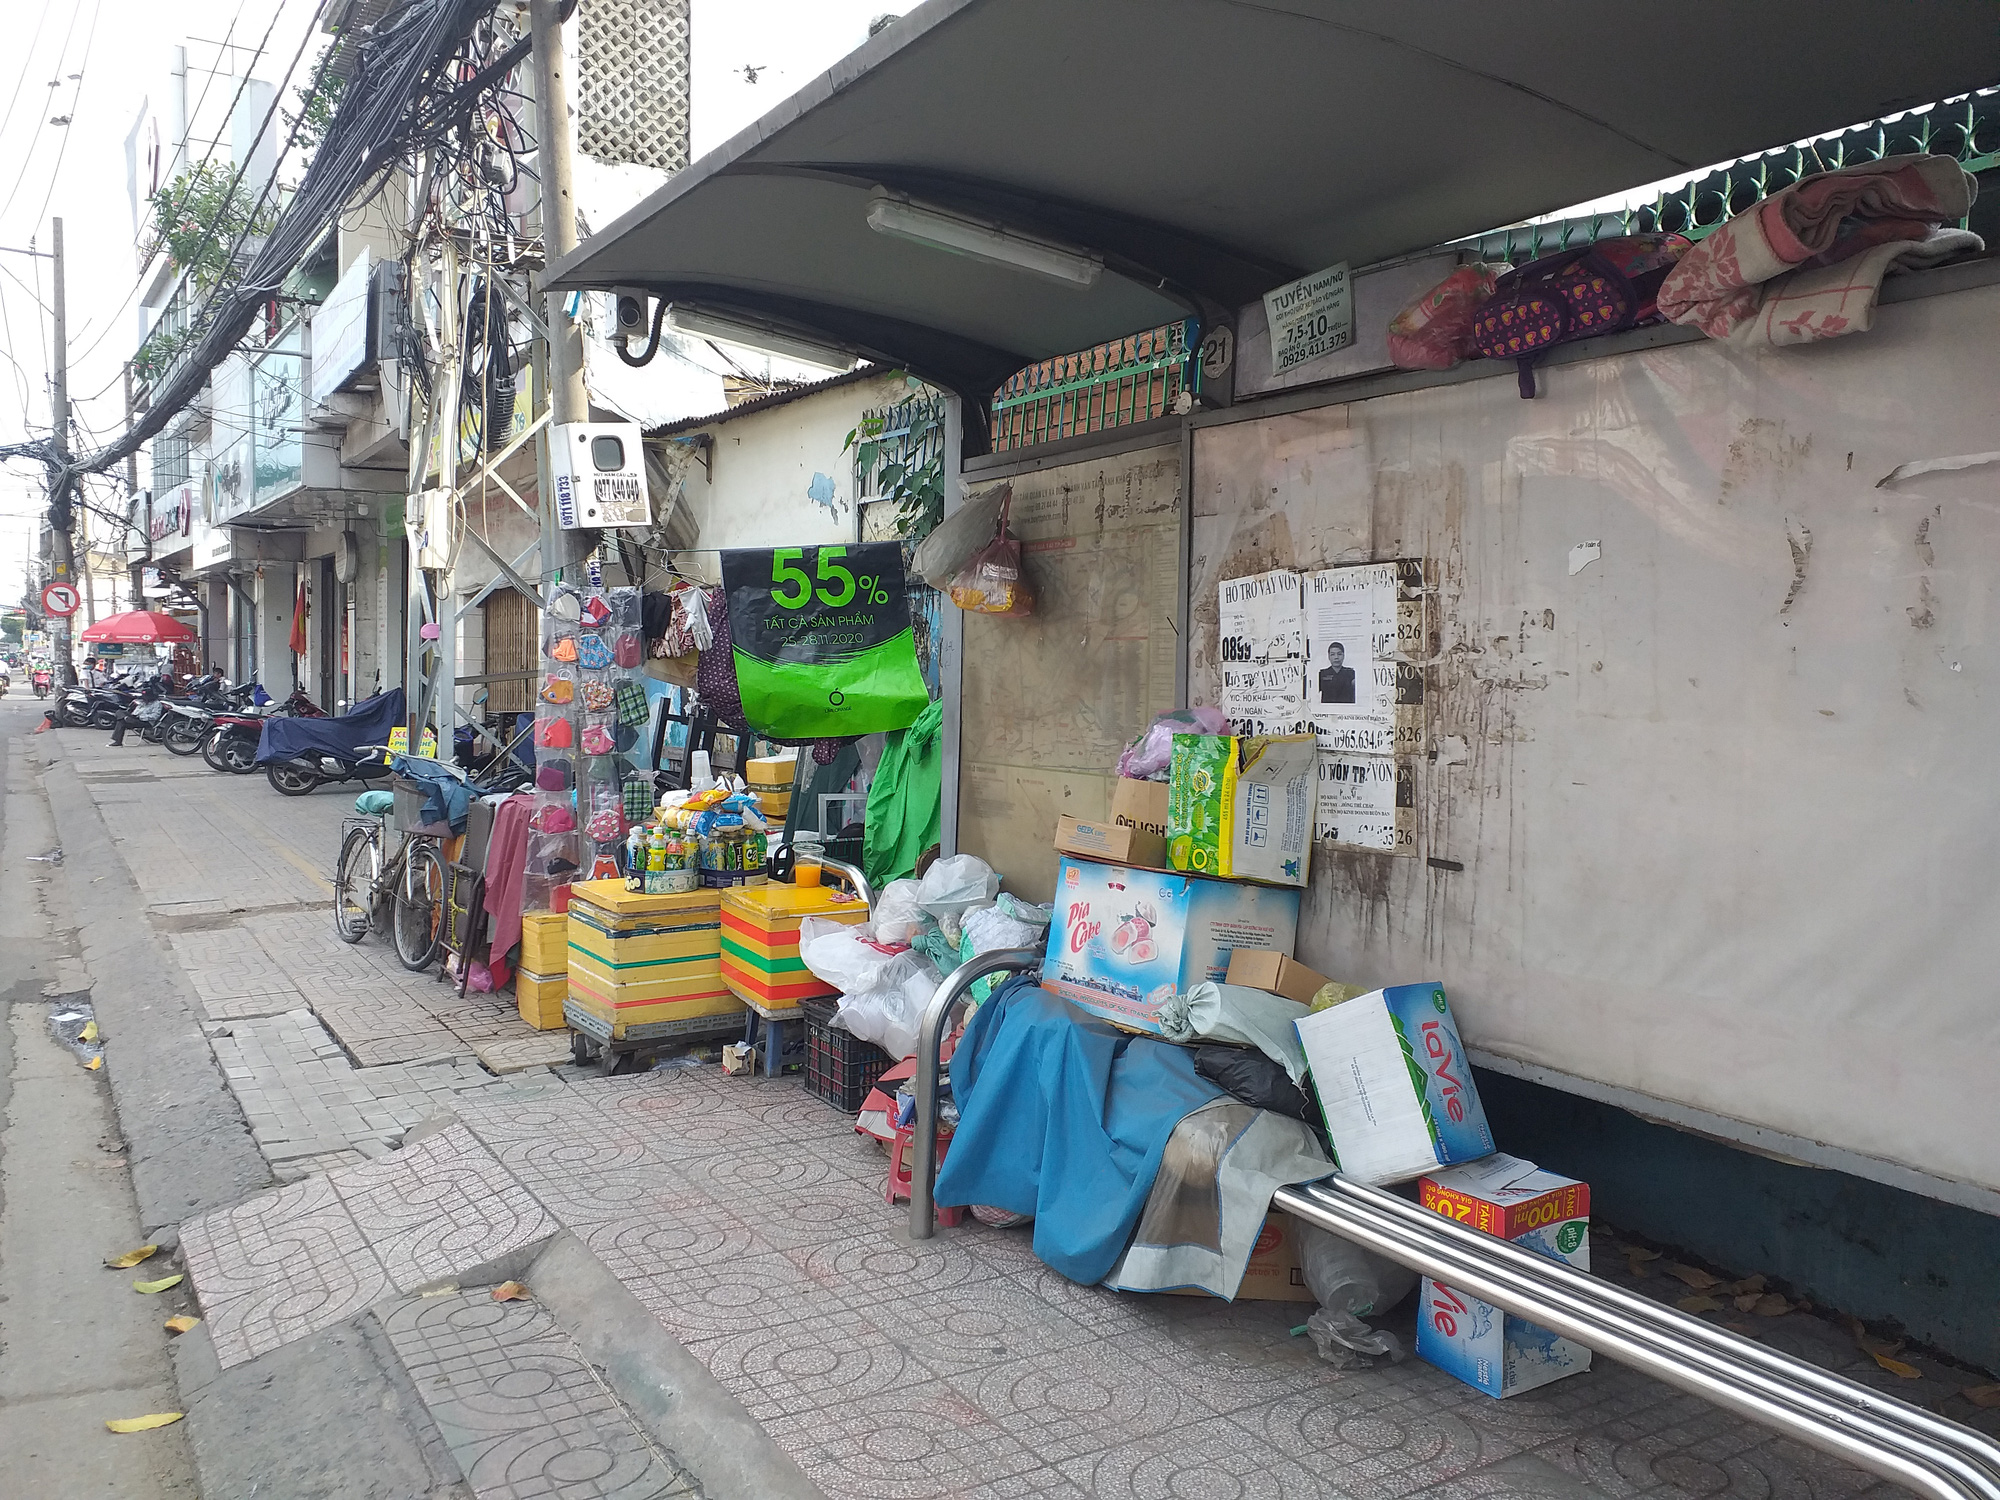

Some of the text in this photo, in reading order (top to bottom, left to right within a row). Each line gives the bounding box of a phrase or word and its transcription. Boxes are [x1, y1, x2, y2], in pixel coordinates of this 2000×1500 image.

[1272, 270, 1344, 312] TUYỂN NAM/NỮ
[1308, 315, 1328, 340] 10
[1205, 337, 1226, 366] 21
[1282, 331, 1347, 368] 0929.411.379
[771, 546, 889, 610] 55%
[763, 610, 875, 630] TẤT CẢ SẢN PHẨM
[1397, 624, 1421, 640] 826
[746, 847, 758, 861] C2
[1066, 901, 1091, 930] Pia
[1070, 920, 1102, 954] Cake
[1437, 1188, 1460, 1202] KHÔNG
[1566, 1187, 1576, 1218] TẶNG
[1513, 1199, 1561, 1229] 100ml
[1566, 1227, 1578, 1249] pH:8
[1482, 1358, 1491, 1387] Nestlé
[1508, 1359, 1518, 1388] 24 chai
